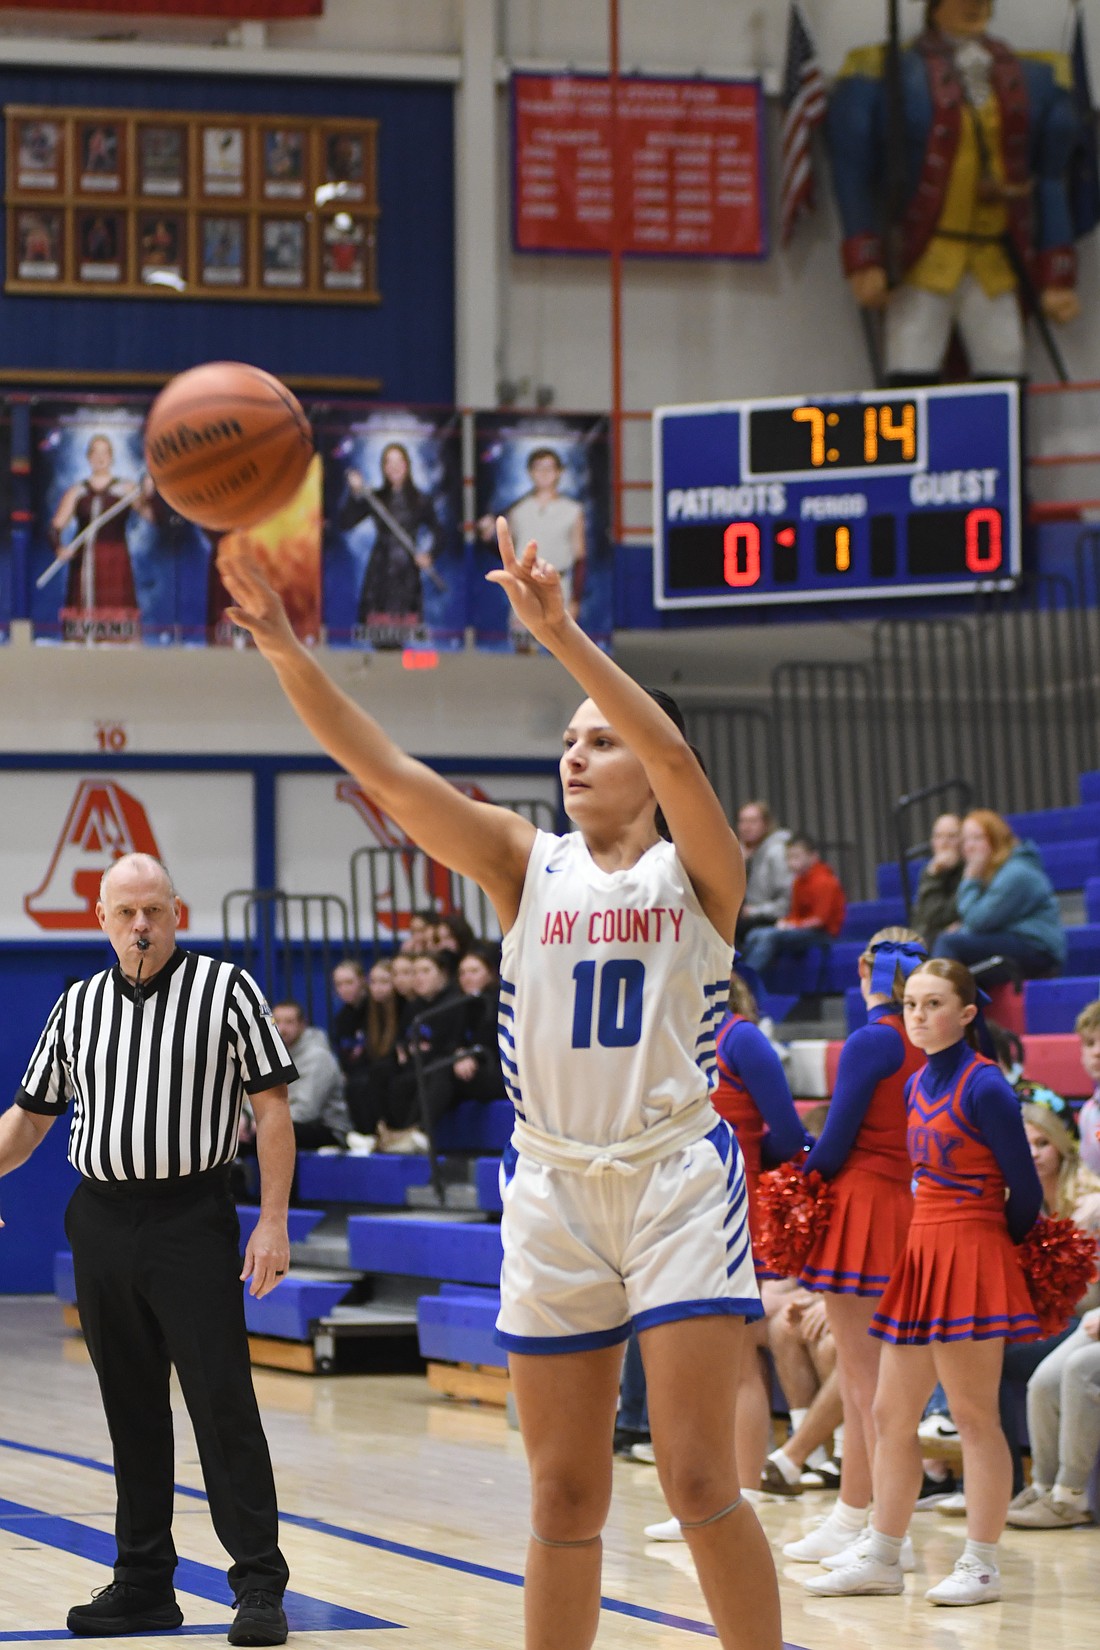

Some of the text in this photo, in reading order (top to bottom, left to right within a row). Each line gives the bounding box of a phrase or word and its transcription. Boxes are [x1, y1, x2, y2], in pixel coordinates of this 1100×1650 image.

[667, 483, 787, 520] PATRIOTS
[801, 493, 867, 520] PERIOD
[909, 469, 999, 505] GUEST
[723, 522, 760, 587] 0
[835, 526, 850, 571] 1
[965, 508, 1002, 573] 0
[541, 908, 684, 945] JAY COUNTY
[572, 959, 645, 1049] 10
